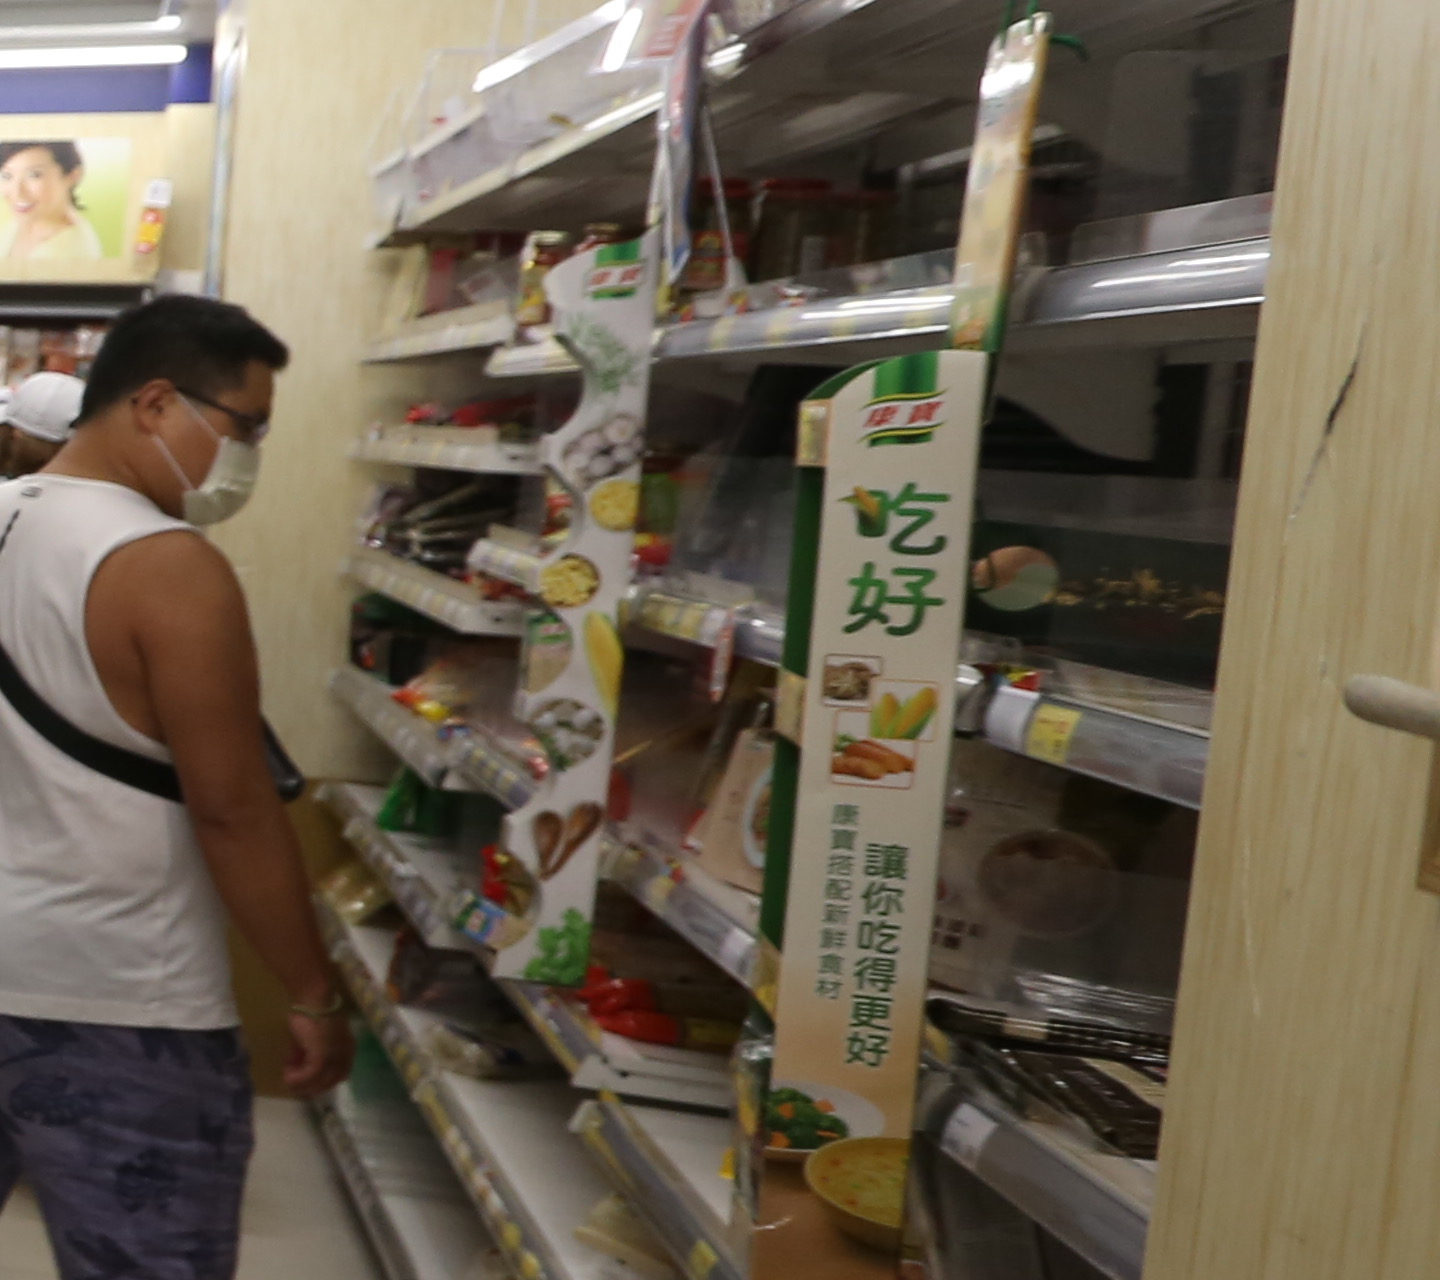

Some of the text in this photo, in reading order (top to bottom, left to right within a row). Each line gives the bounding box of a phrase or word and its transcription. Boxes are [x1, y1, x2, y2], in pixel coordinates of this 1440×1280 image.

[840, 482, 952, 637] 吃好
[845, 842, 910, 1068] 讓你吃得更好
